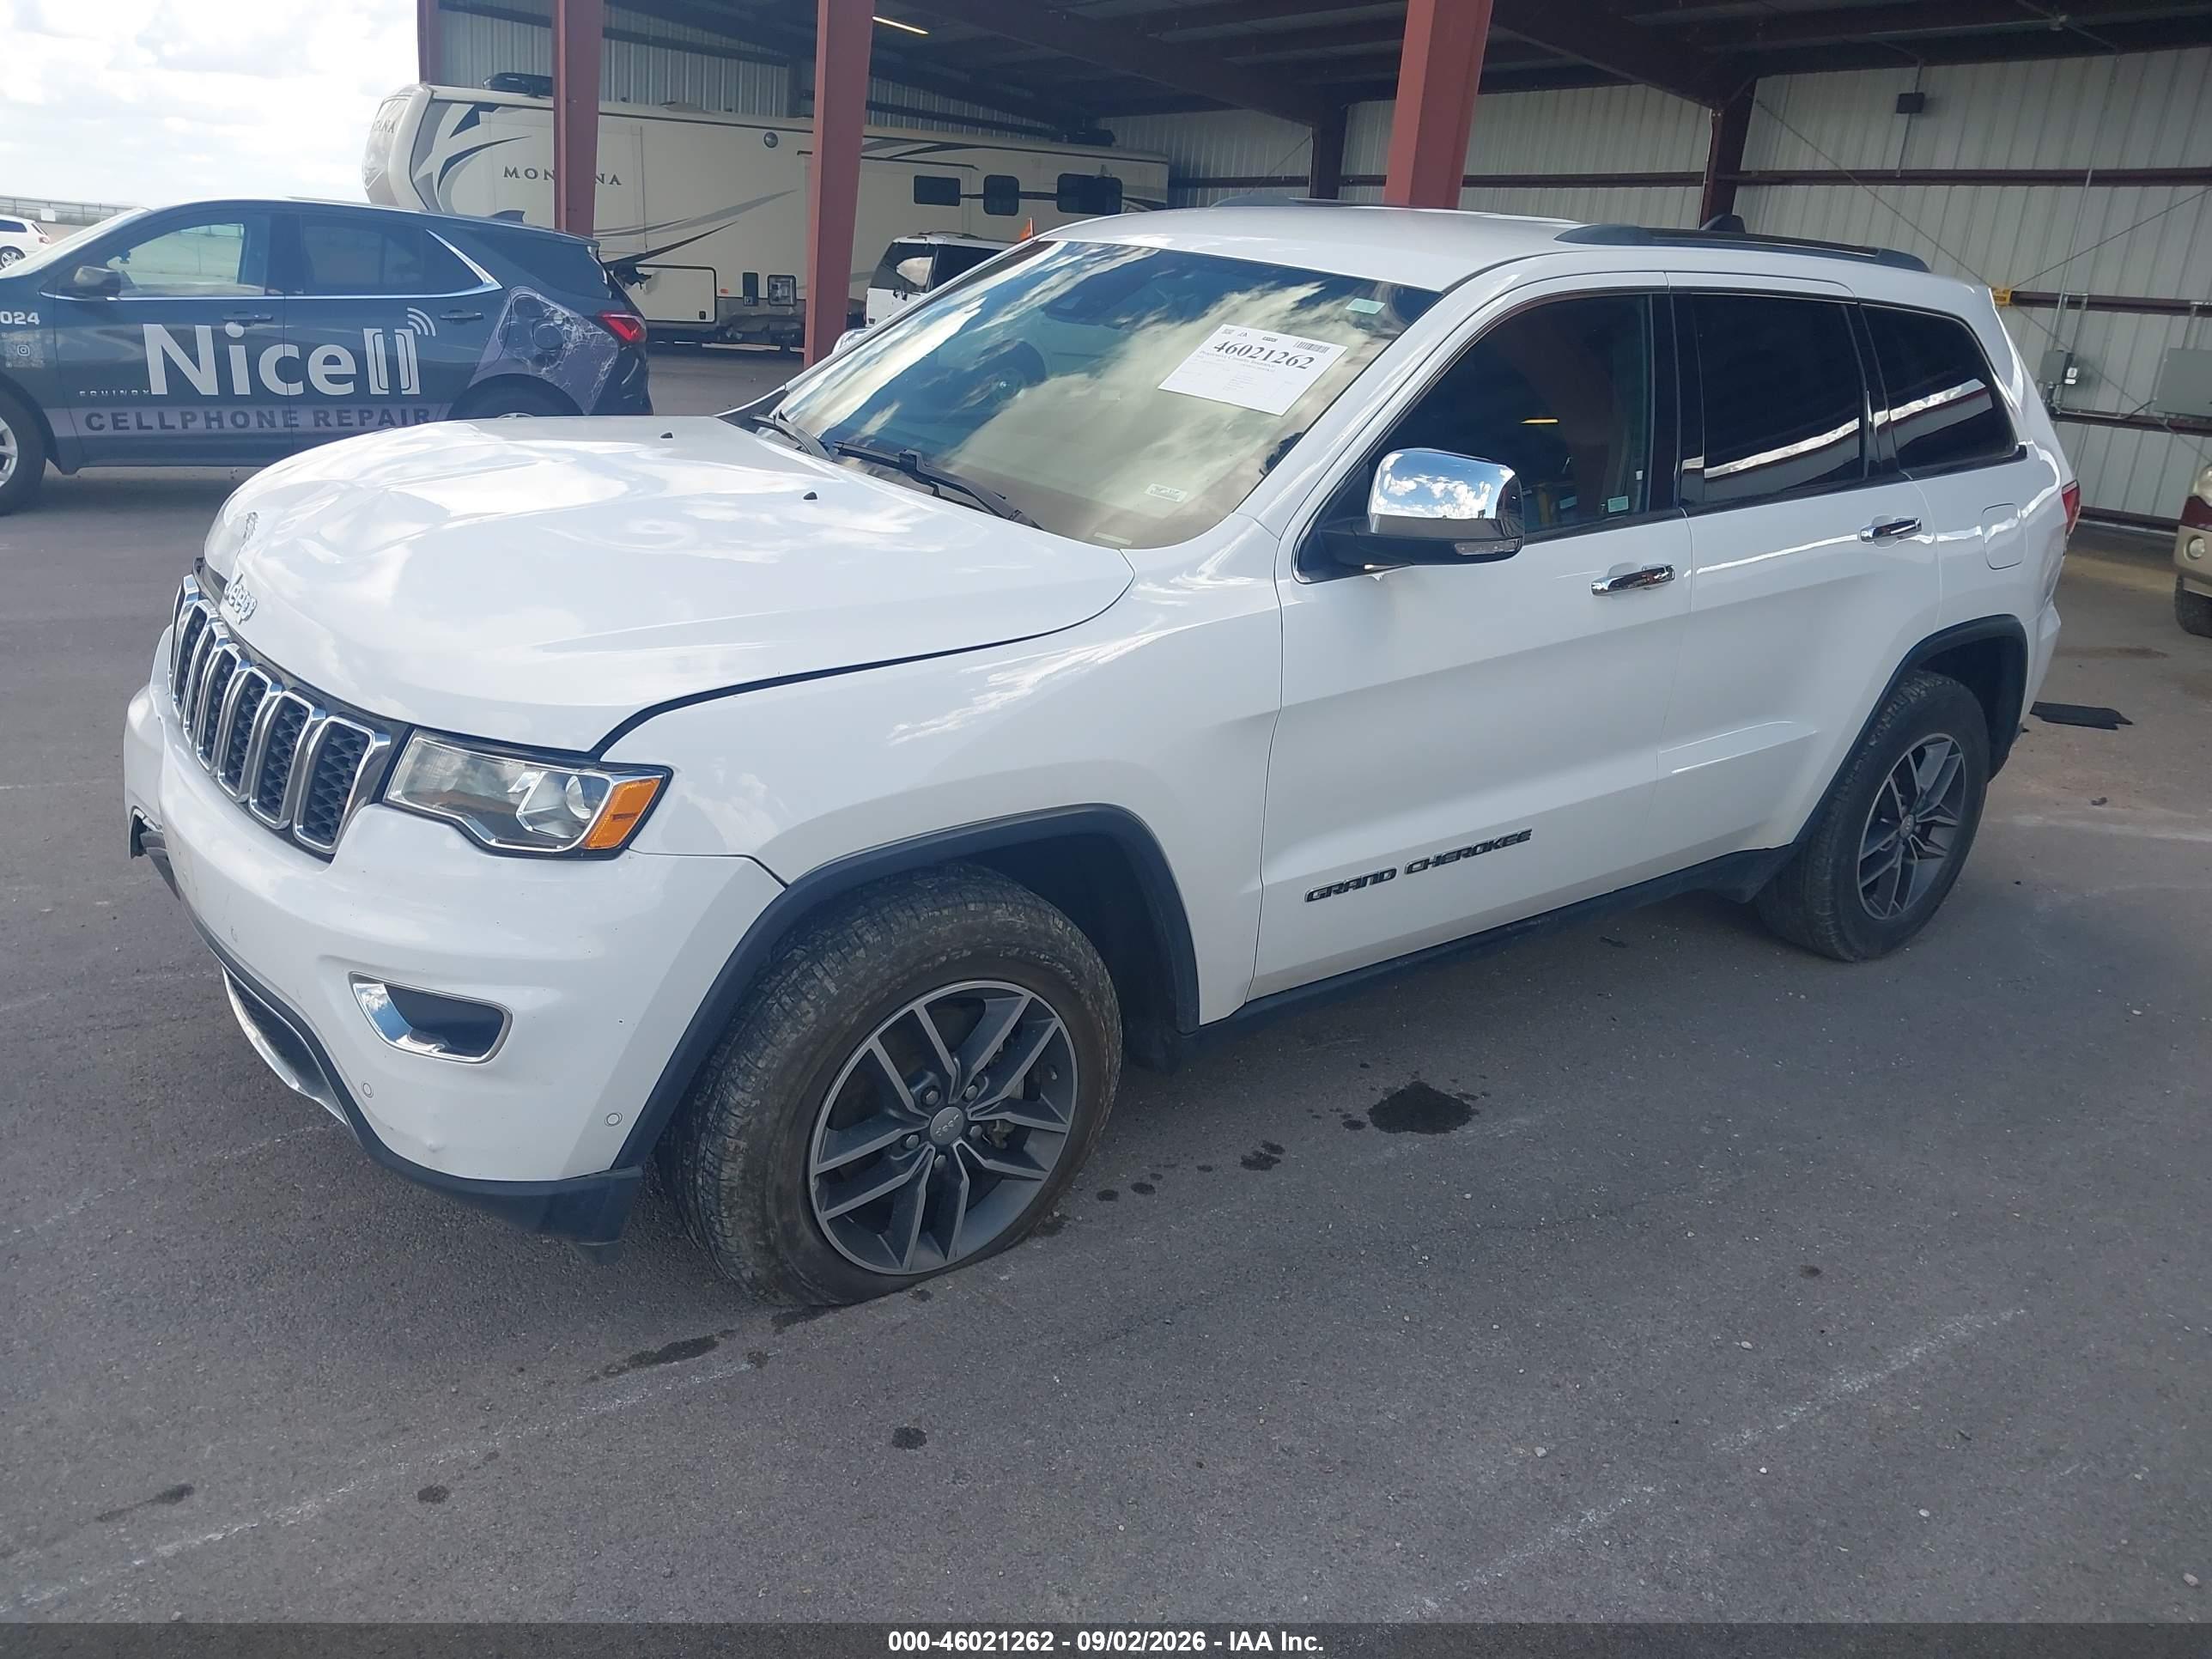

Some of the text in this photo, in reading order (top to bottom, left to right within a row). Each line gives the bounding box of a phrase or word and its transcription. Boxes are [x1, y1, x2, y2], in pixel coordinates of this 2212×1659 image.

[503, 166, 622, 185] MONNA
[143, 321, 421, 396] Nicell
[1213, 341, 1315, 370] 46021262
[85, 408, 429, 431] CELLPHONE REPAIR
[1304, 829, 1533, 902] GRAND CHEROKEE
